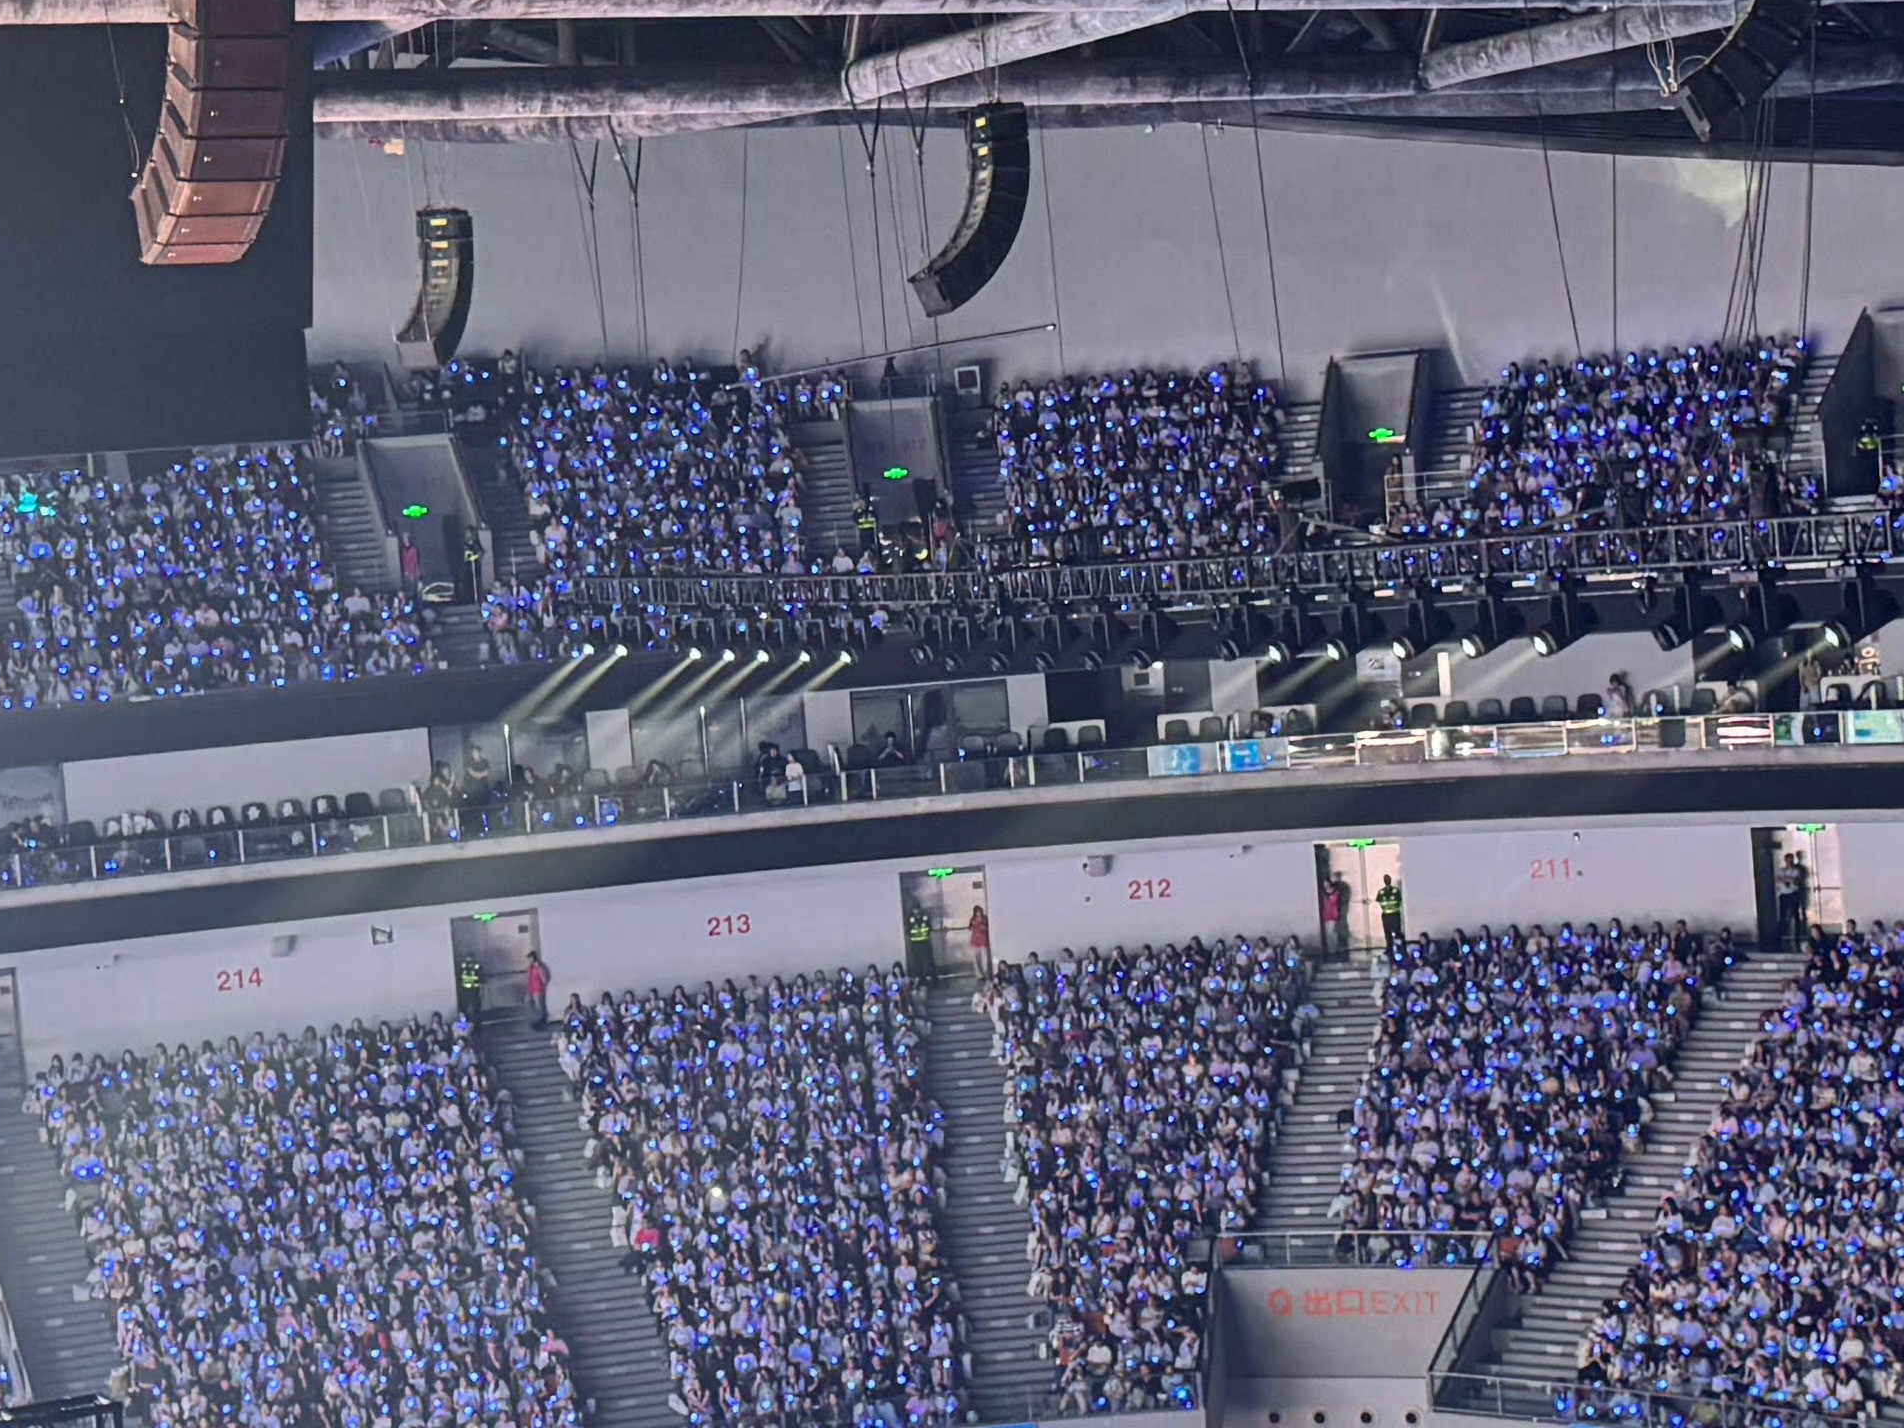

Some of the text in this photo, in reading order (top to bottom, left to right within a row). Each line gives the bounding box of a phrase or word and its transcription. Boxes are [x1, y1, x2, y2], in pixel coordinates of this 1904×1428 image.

[1530, 856, 1573, 883] 211
[1128, 877, 1173, 903] 212
[706, 913, 753, 939] 213
[217, 967, 265, 994] 214
[1305, 1289, 1365, 1317] 出口
[1371, 1291, 1438, 1316] EXIT
